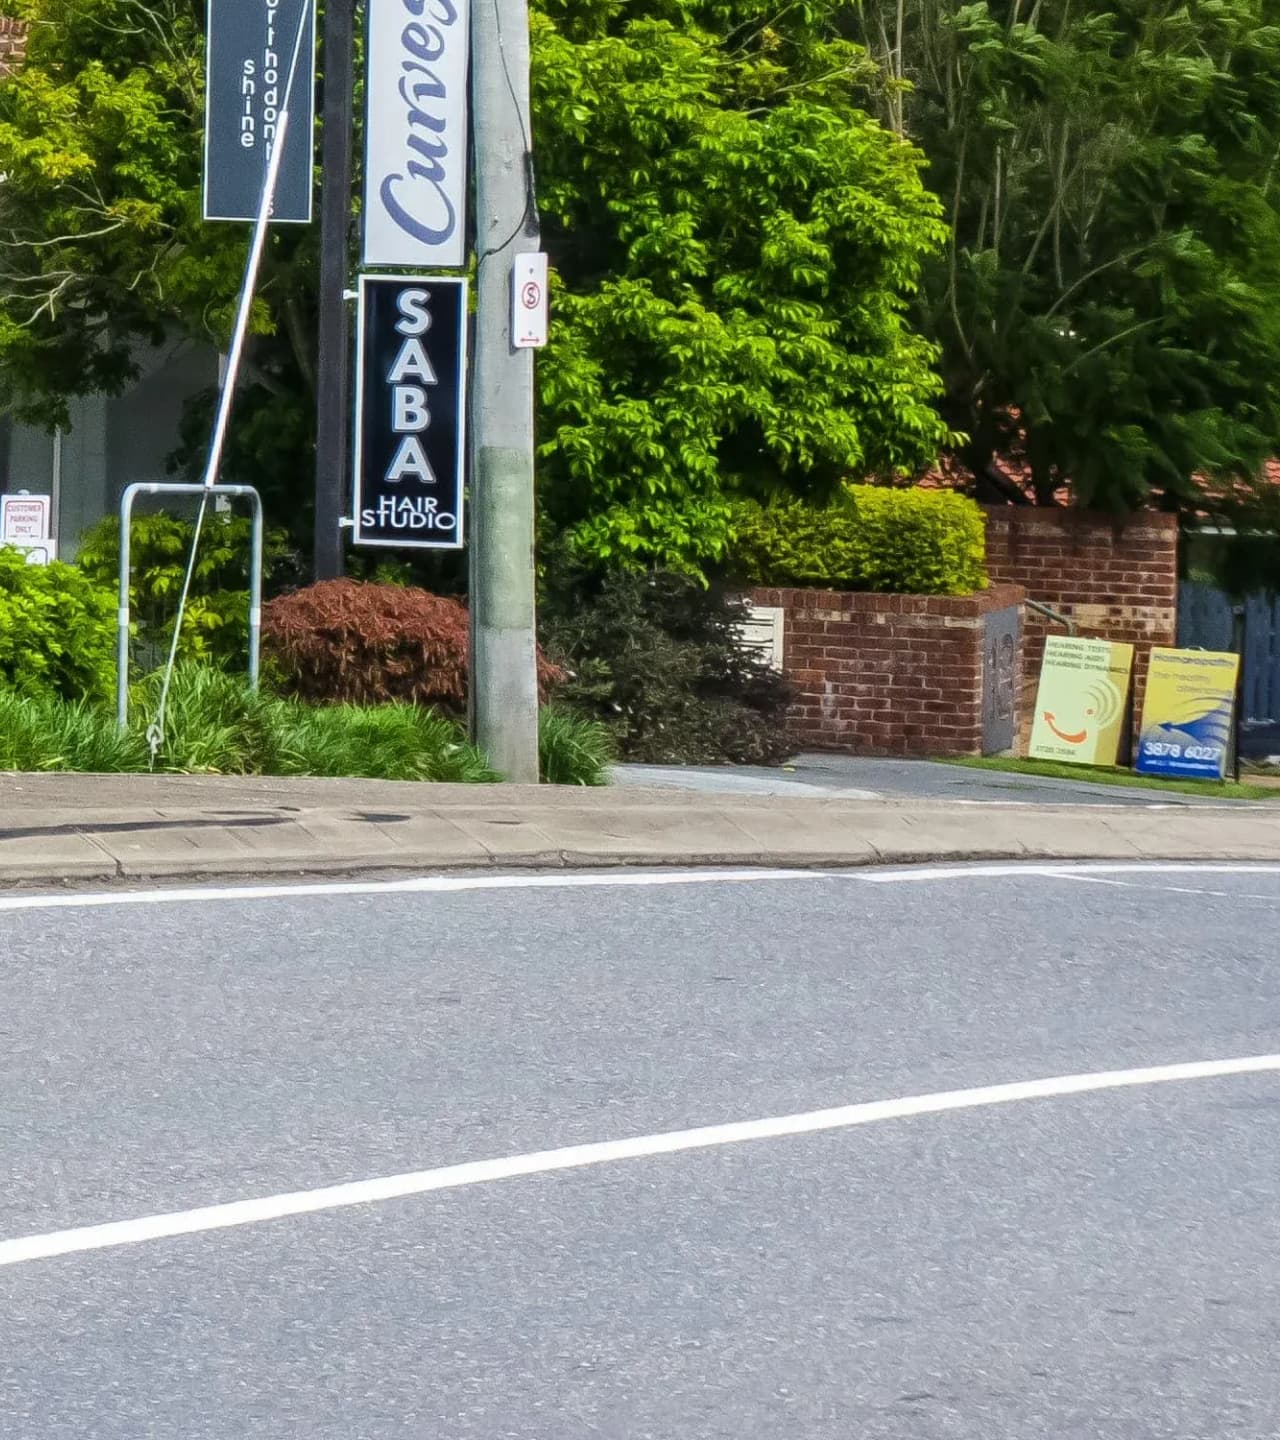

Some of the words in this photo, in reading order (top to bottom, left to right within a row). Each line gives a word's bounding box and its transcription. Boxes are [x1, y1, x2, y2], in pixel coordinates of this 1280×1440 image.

[240, 59, 256, 148] shine
[384, 287, 438, 484] SABA
[378, 495, 439, 513] HAIR
[361, 508, 457, 531] STUDIO
[1143, 741, 1181, 758] 3878
